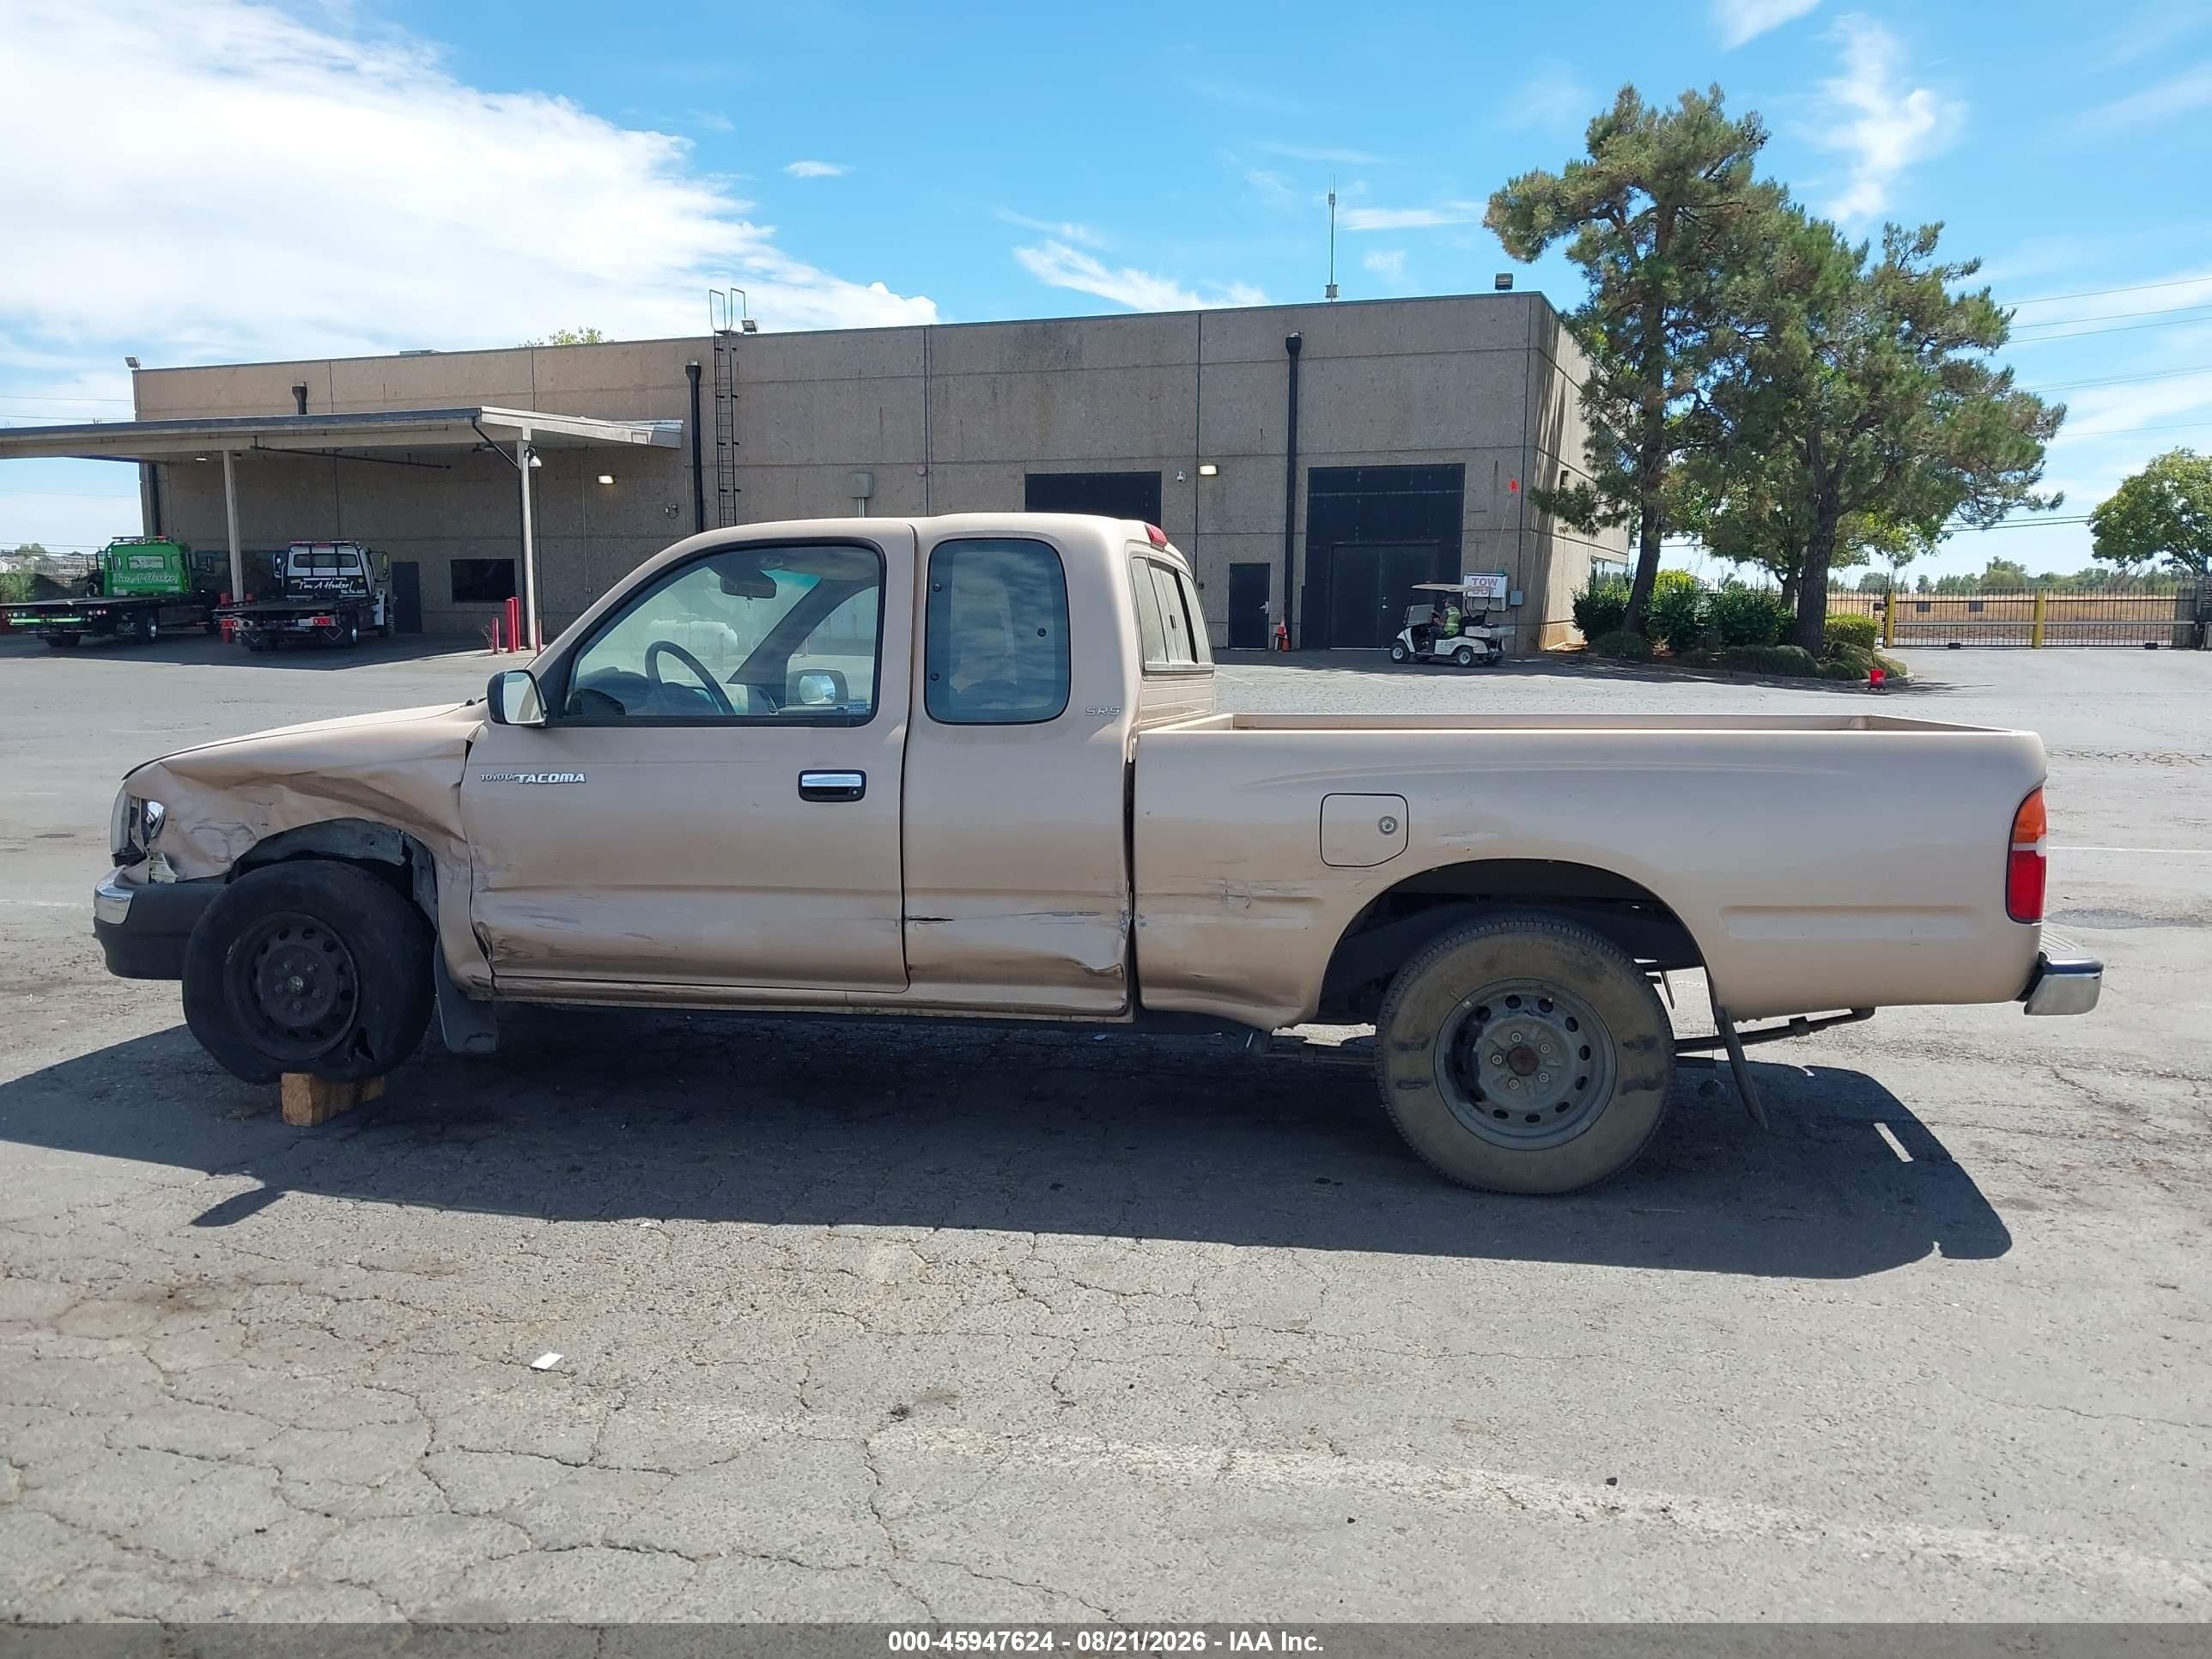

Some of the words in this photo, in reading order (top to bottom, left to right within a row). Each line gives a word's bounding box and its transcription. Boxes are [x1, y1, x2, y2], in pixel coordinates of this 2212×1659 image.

[299, 581, 313, 590] I'm
[313, 580, 323, 590] A
[1472, 577, 1498, 586] TOW
[481, 773, 515, 781] TOYOTA
[514, 773, 586, 783] TACOMA
